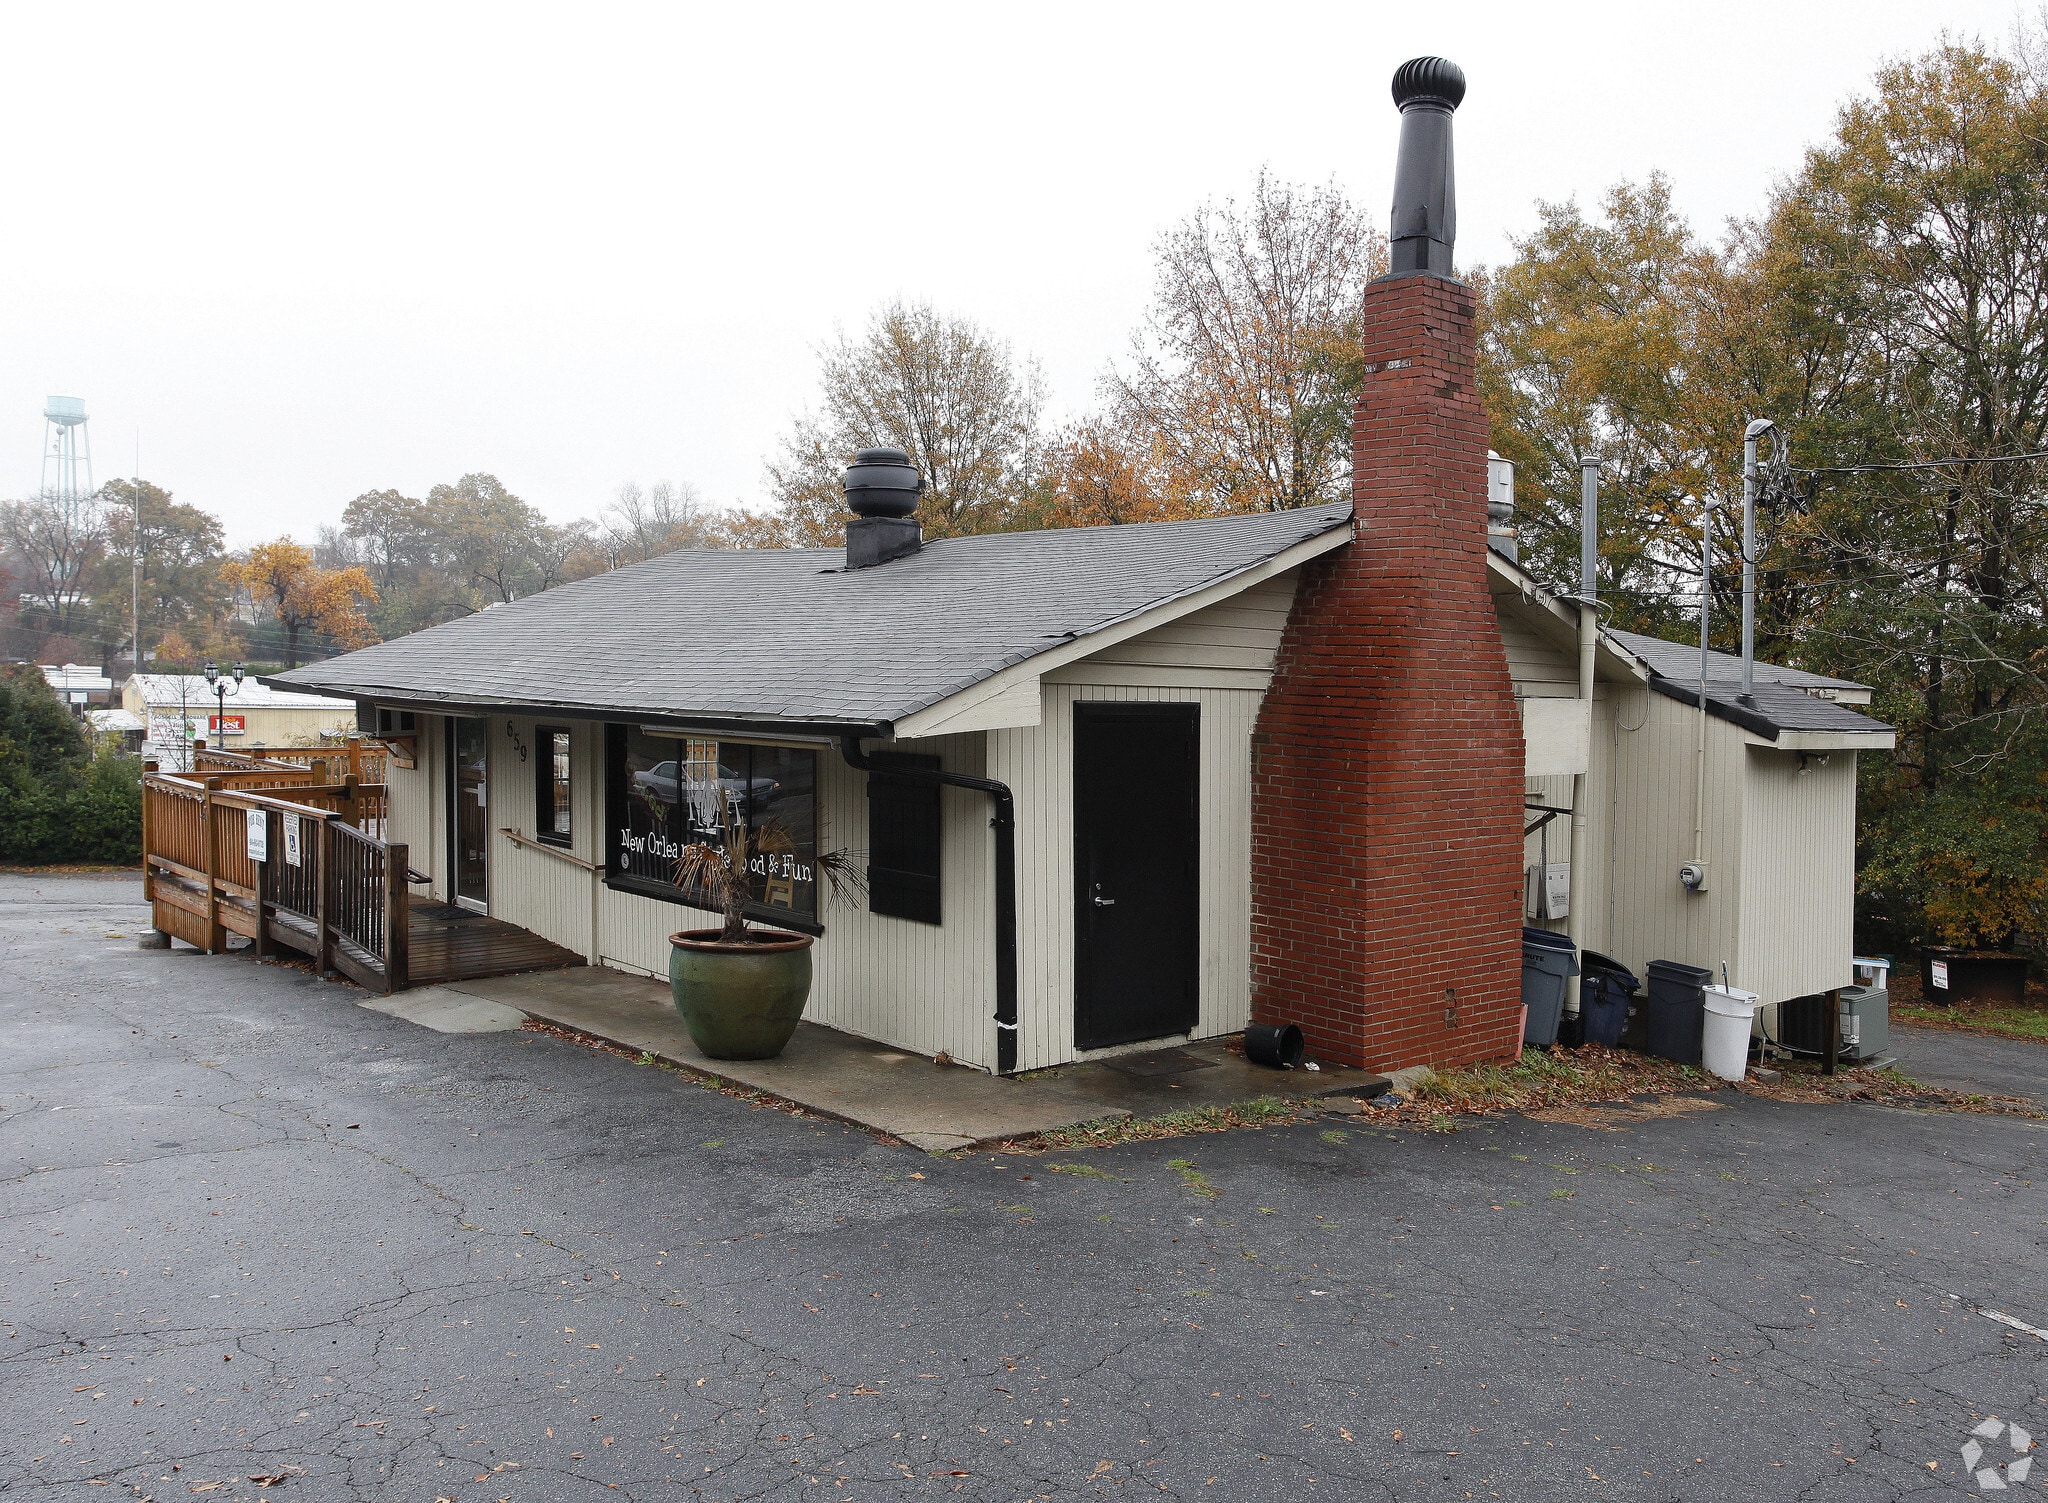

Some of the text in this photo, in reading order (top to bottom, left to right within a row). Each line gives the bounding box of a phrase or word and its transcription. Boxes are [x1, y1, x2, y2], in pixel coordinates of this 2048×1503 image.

[215, 719, 240, 730] Best
[507, 720, 527, 762] 659
[621, 829, 645, 853] New
[768, 853, 779, 873] &
[782, 854, 813, 882] Fun
